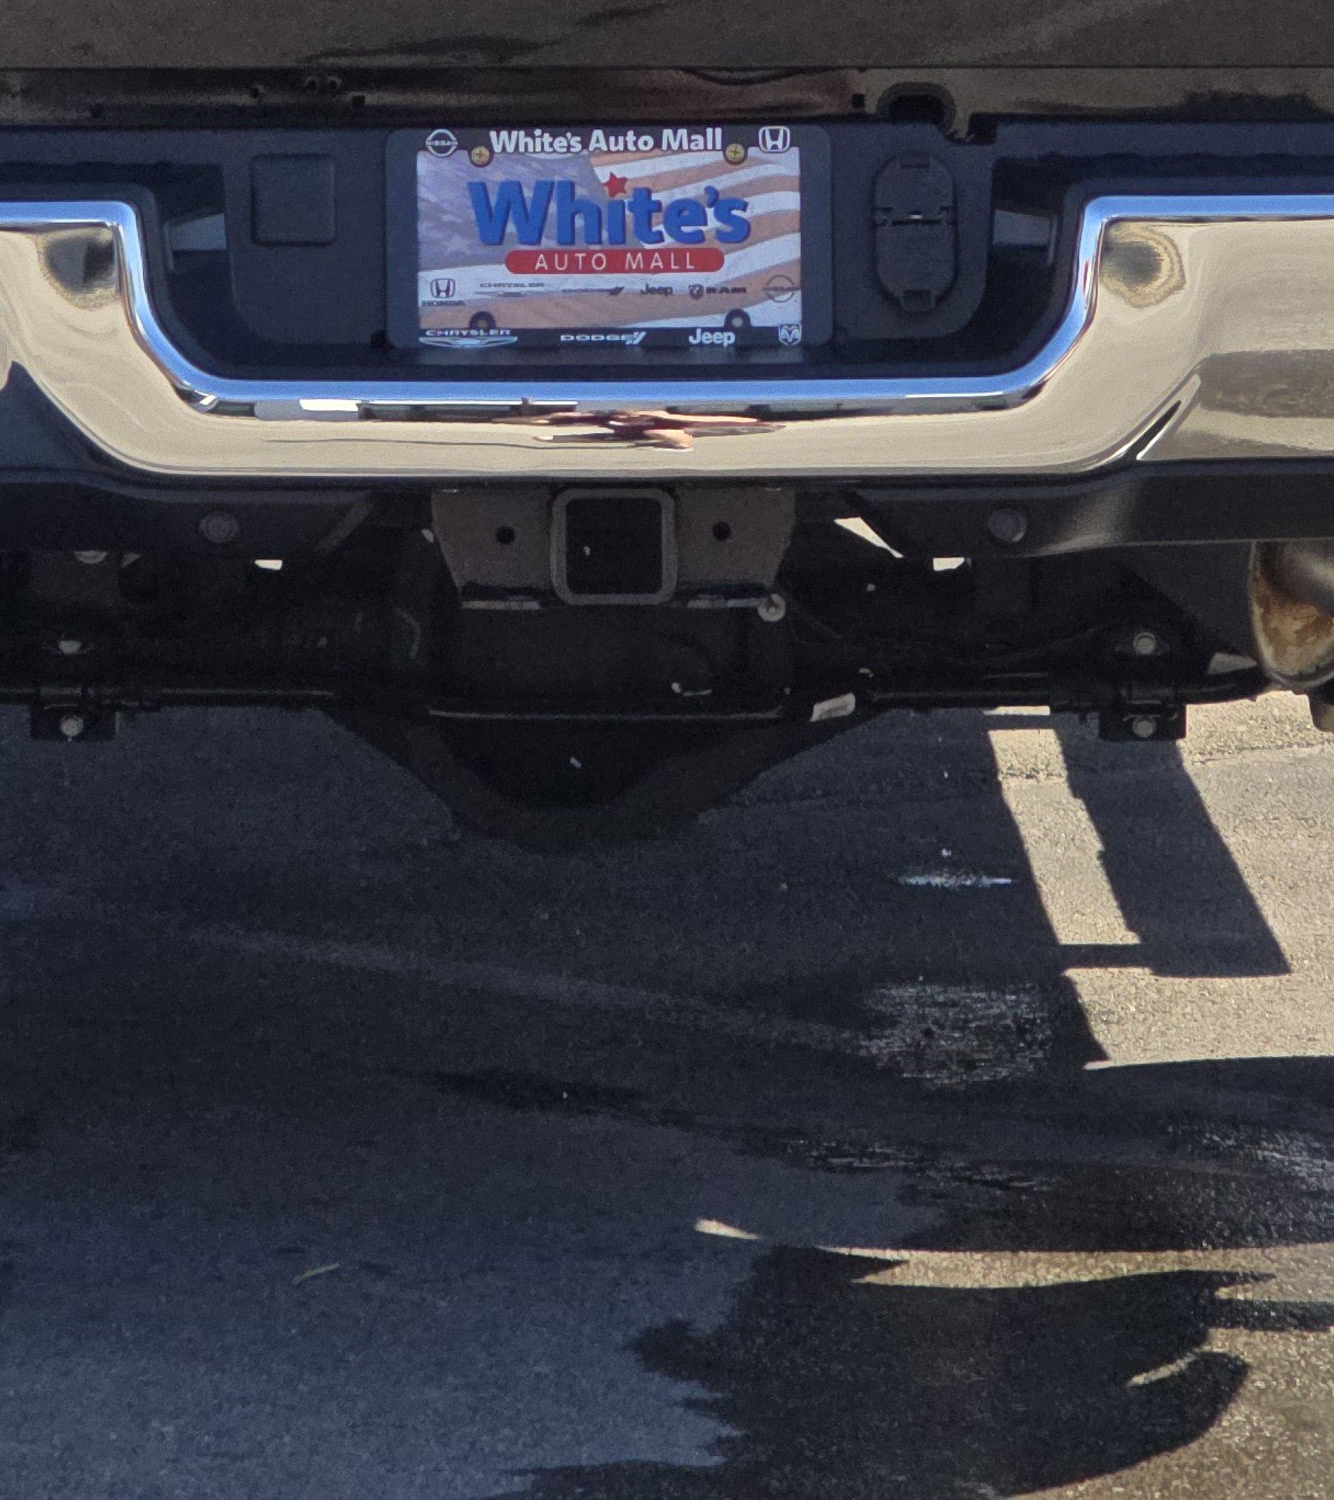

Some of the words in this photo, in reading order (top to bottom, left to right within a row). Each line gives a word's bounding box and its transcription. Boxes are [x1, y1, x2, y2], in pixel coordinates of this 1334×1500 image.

[489, 129, 582, 153] White's
[588, 129, 654, 152] Auto
[661, 127, 722, 151] Mall
[468, 172, 751, 246] White's
[535, 253, 606, 270] AUTO
[625, 253, 695, 270] MALL
[640, 283, 673, 297] Jeep
[425, 329, 511, 337] CHRYSLER
[560, 334, 634, 342] DODGE
[688, 328, 736, 347] Jeep
